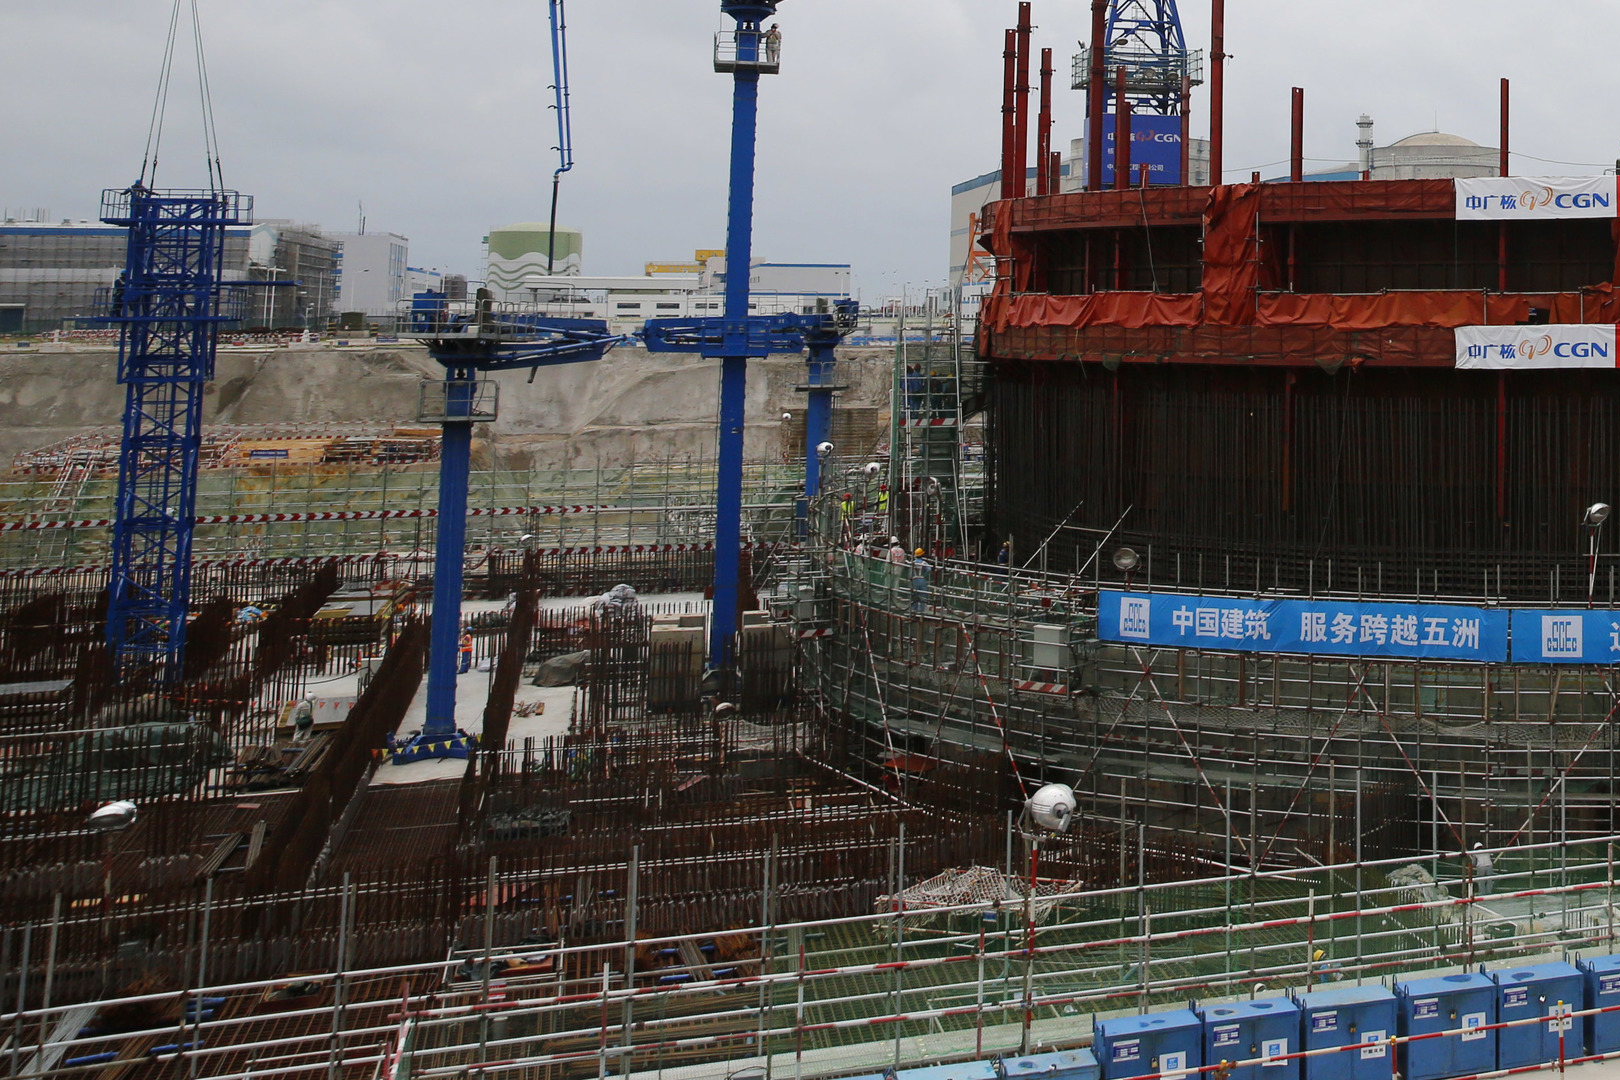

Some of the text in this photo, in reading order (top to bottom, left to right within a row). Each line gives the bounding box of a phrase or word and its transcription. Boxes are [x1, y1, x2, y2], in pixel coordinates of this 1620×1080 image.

[1465, 192, 1609, 210] 中广核 CGN
[1467, 342, 1608, 359] 中广核 CGN
[1172, 605, 1480, 650] 中国建筑 服务跨越五洲
